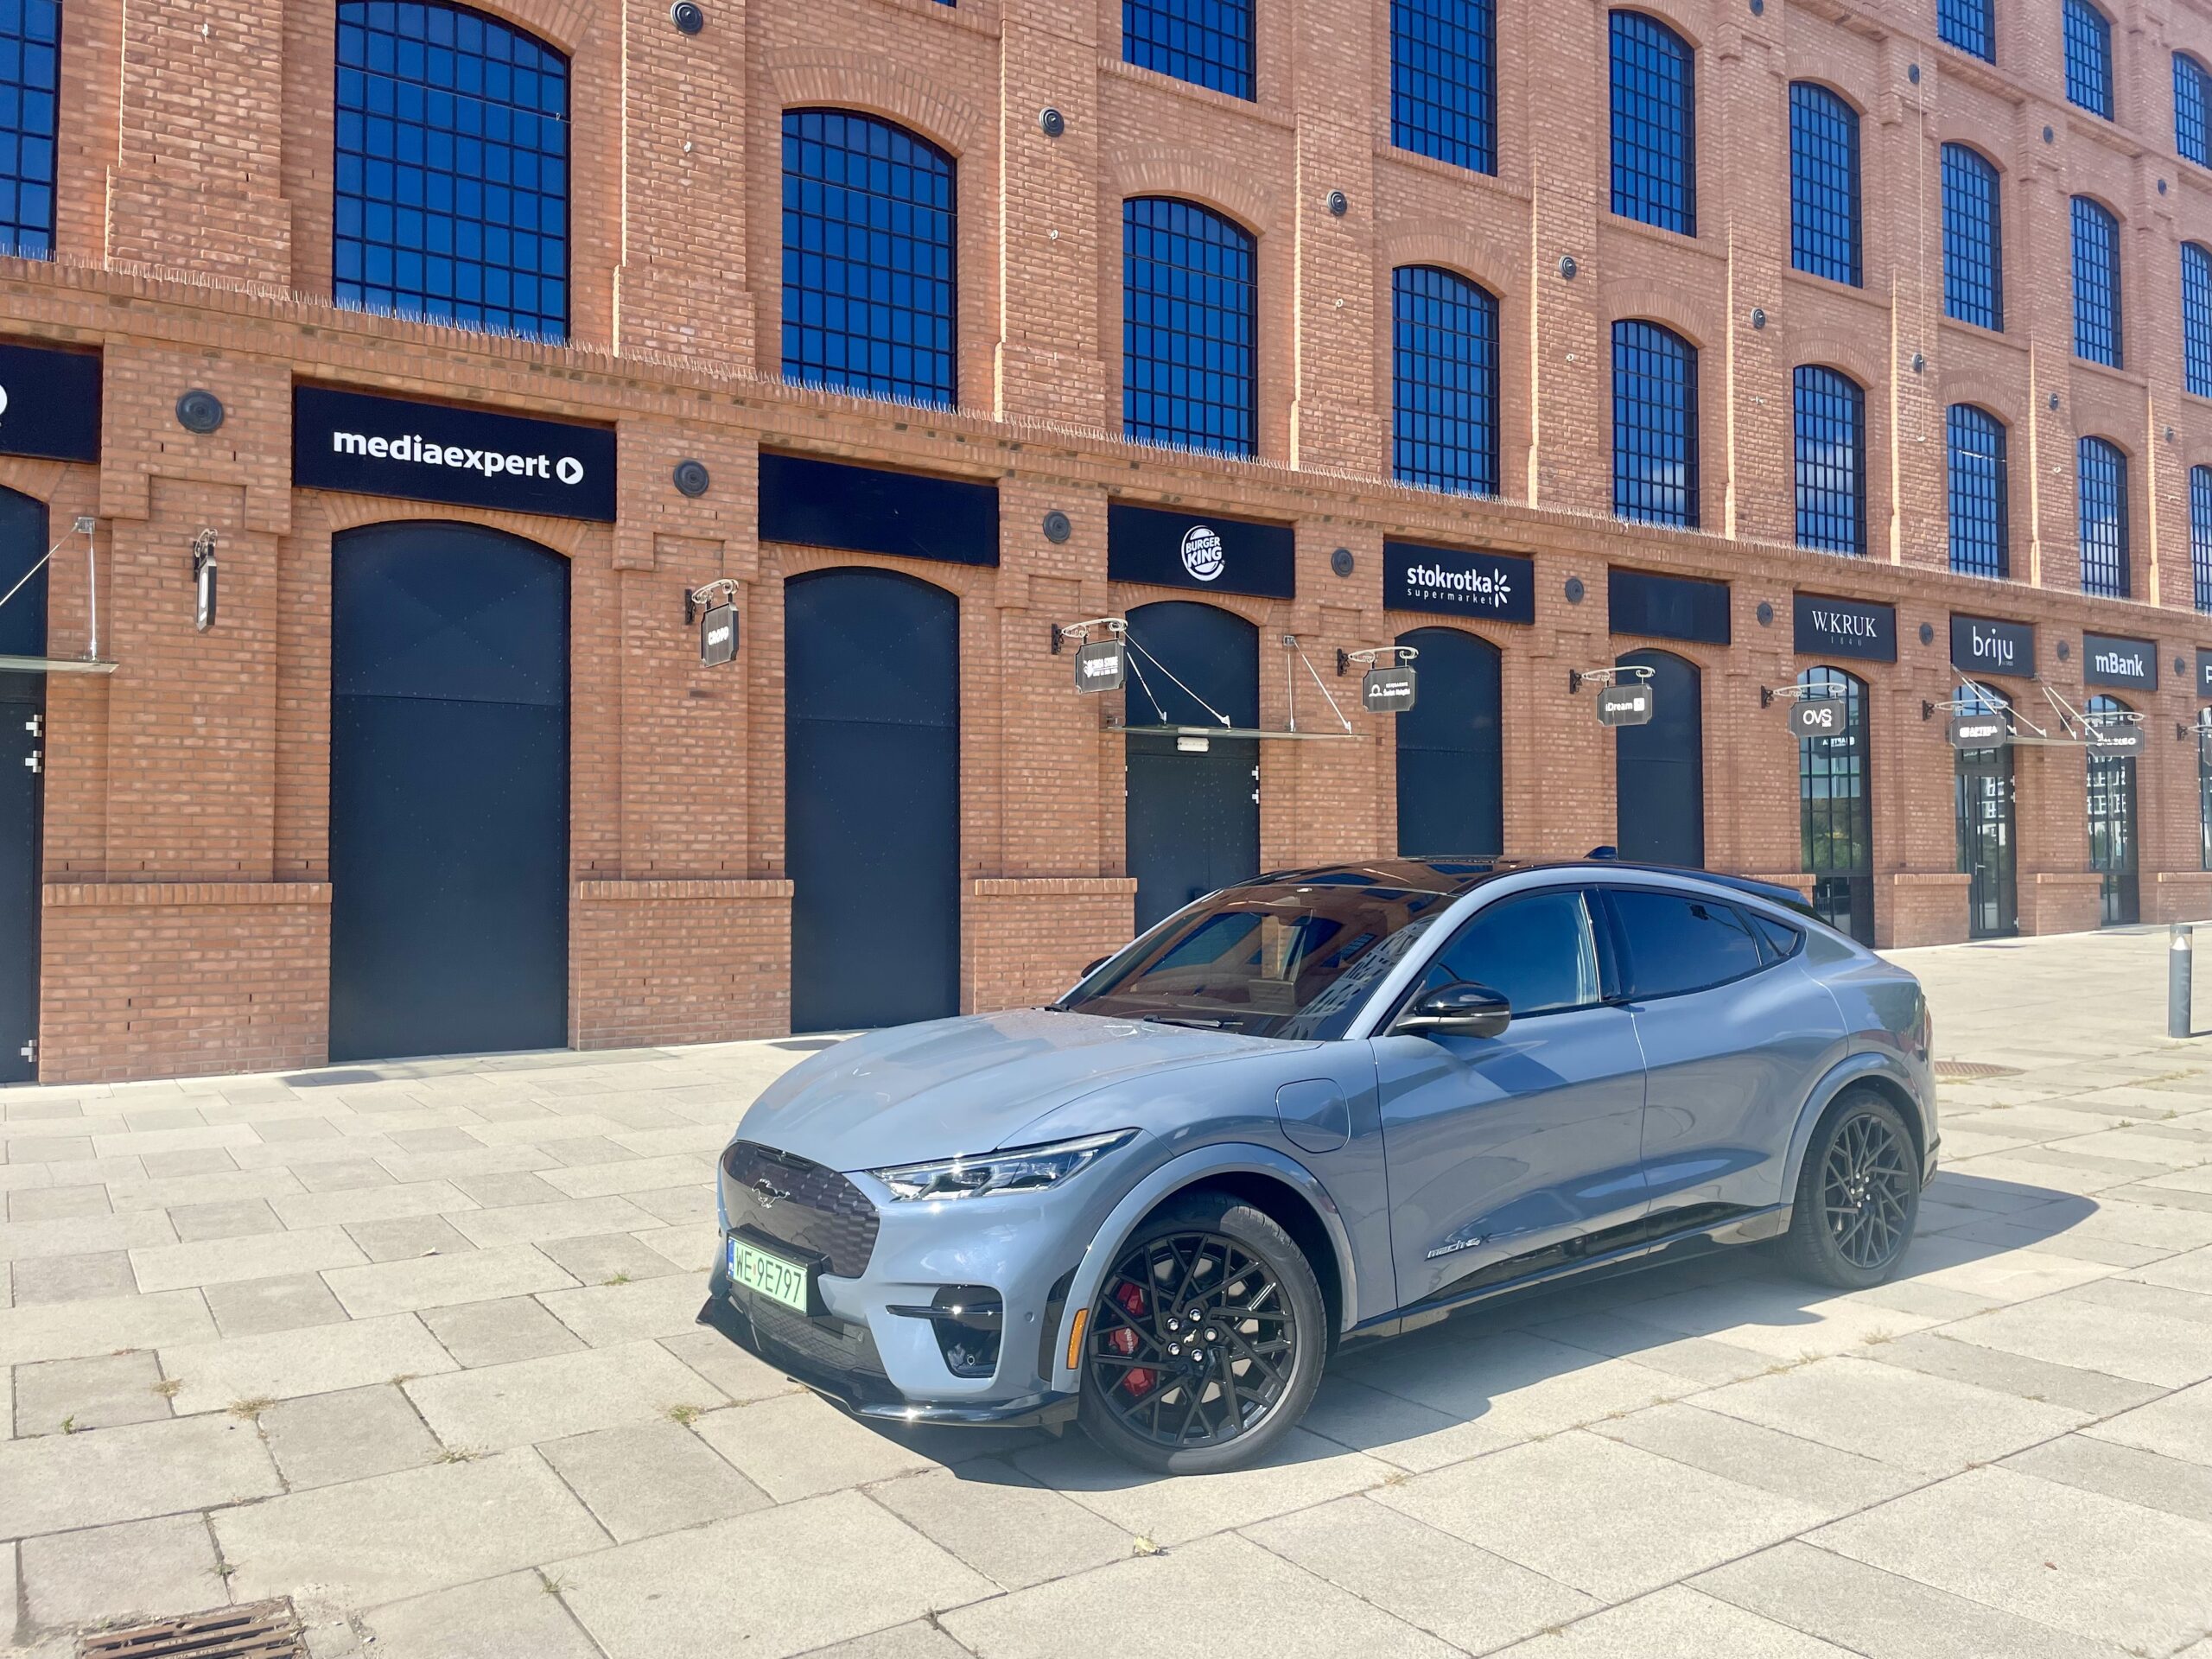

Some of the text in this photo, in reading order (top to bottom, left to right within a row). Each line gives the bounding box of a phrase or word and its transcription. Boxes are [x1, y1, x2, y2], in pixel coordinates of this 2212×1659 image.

[334, 431, 550, 479] mediaexpert
[1185, 536, 1220, 554] BURGER
[1187, 546, 1223, 568] KING
[1407, 564, 1492, 594] stokrotka
[1407, 588, 1492, 605] supermarket
[1831, 635, 1862, 646] 1840
[1973, 626, 2013, 667] briju
[2094, 652, 2144, 677] mBank
[1605, 702, 1633, 712] iDream
[1802, 708, 1832, 725] OVS
[736, 1246, 802, 1303] WE 9E797
